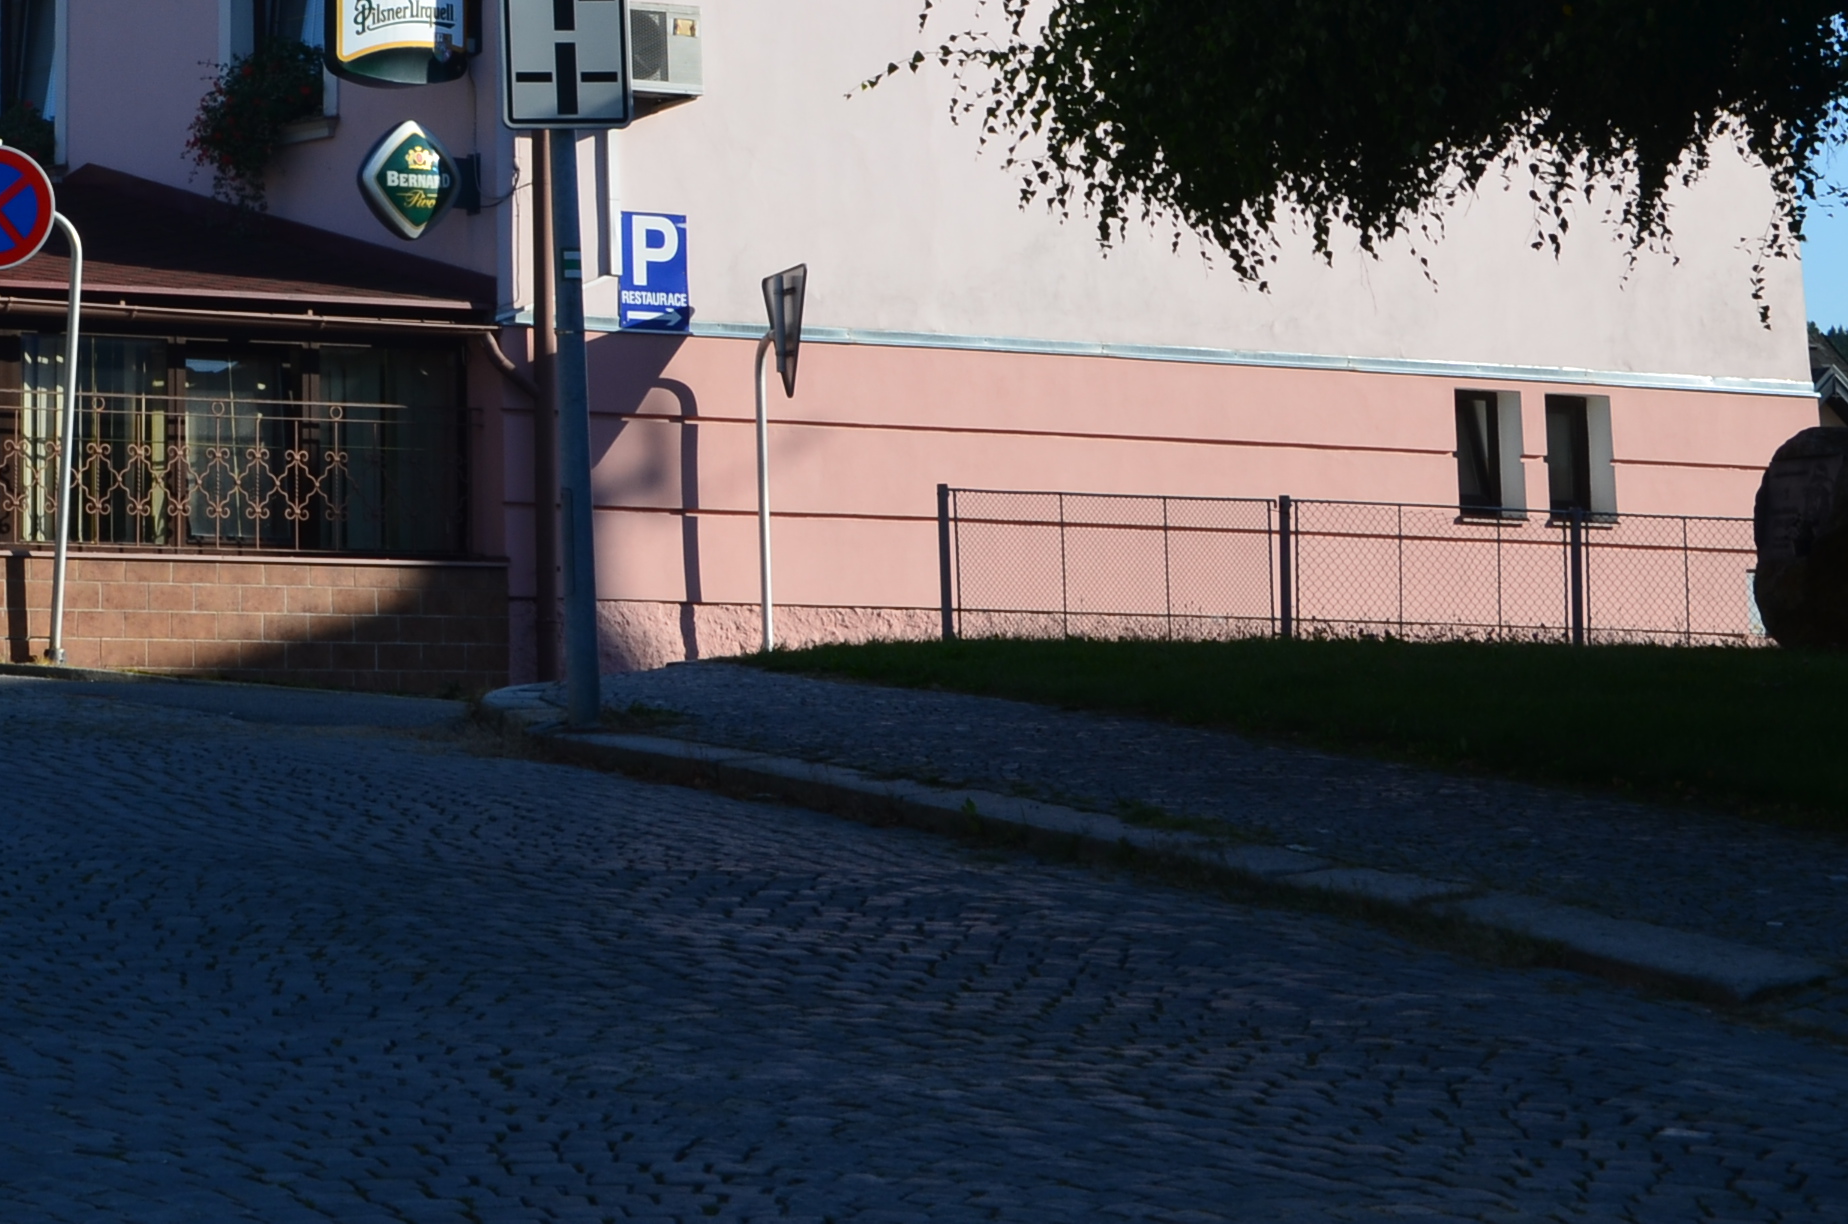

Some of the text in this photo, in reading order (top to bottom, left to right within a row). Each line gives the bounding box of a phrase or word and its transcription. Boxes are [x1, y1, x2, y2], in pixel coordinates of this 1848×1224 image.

[386, 170, 451, 189] BERNARD
[632, 214, 679, 286] P
[621, 290, 688, 307] RESTAURACE
